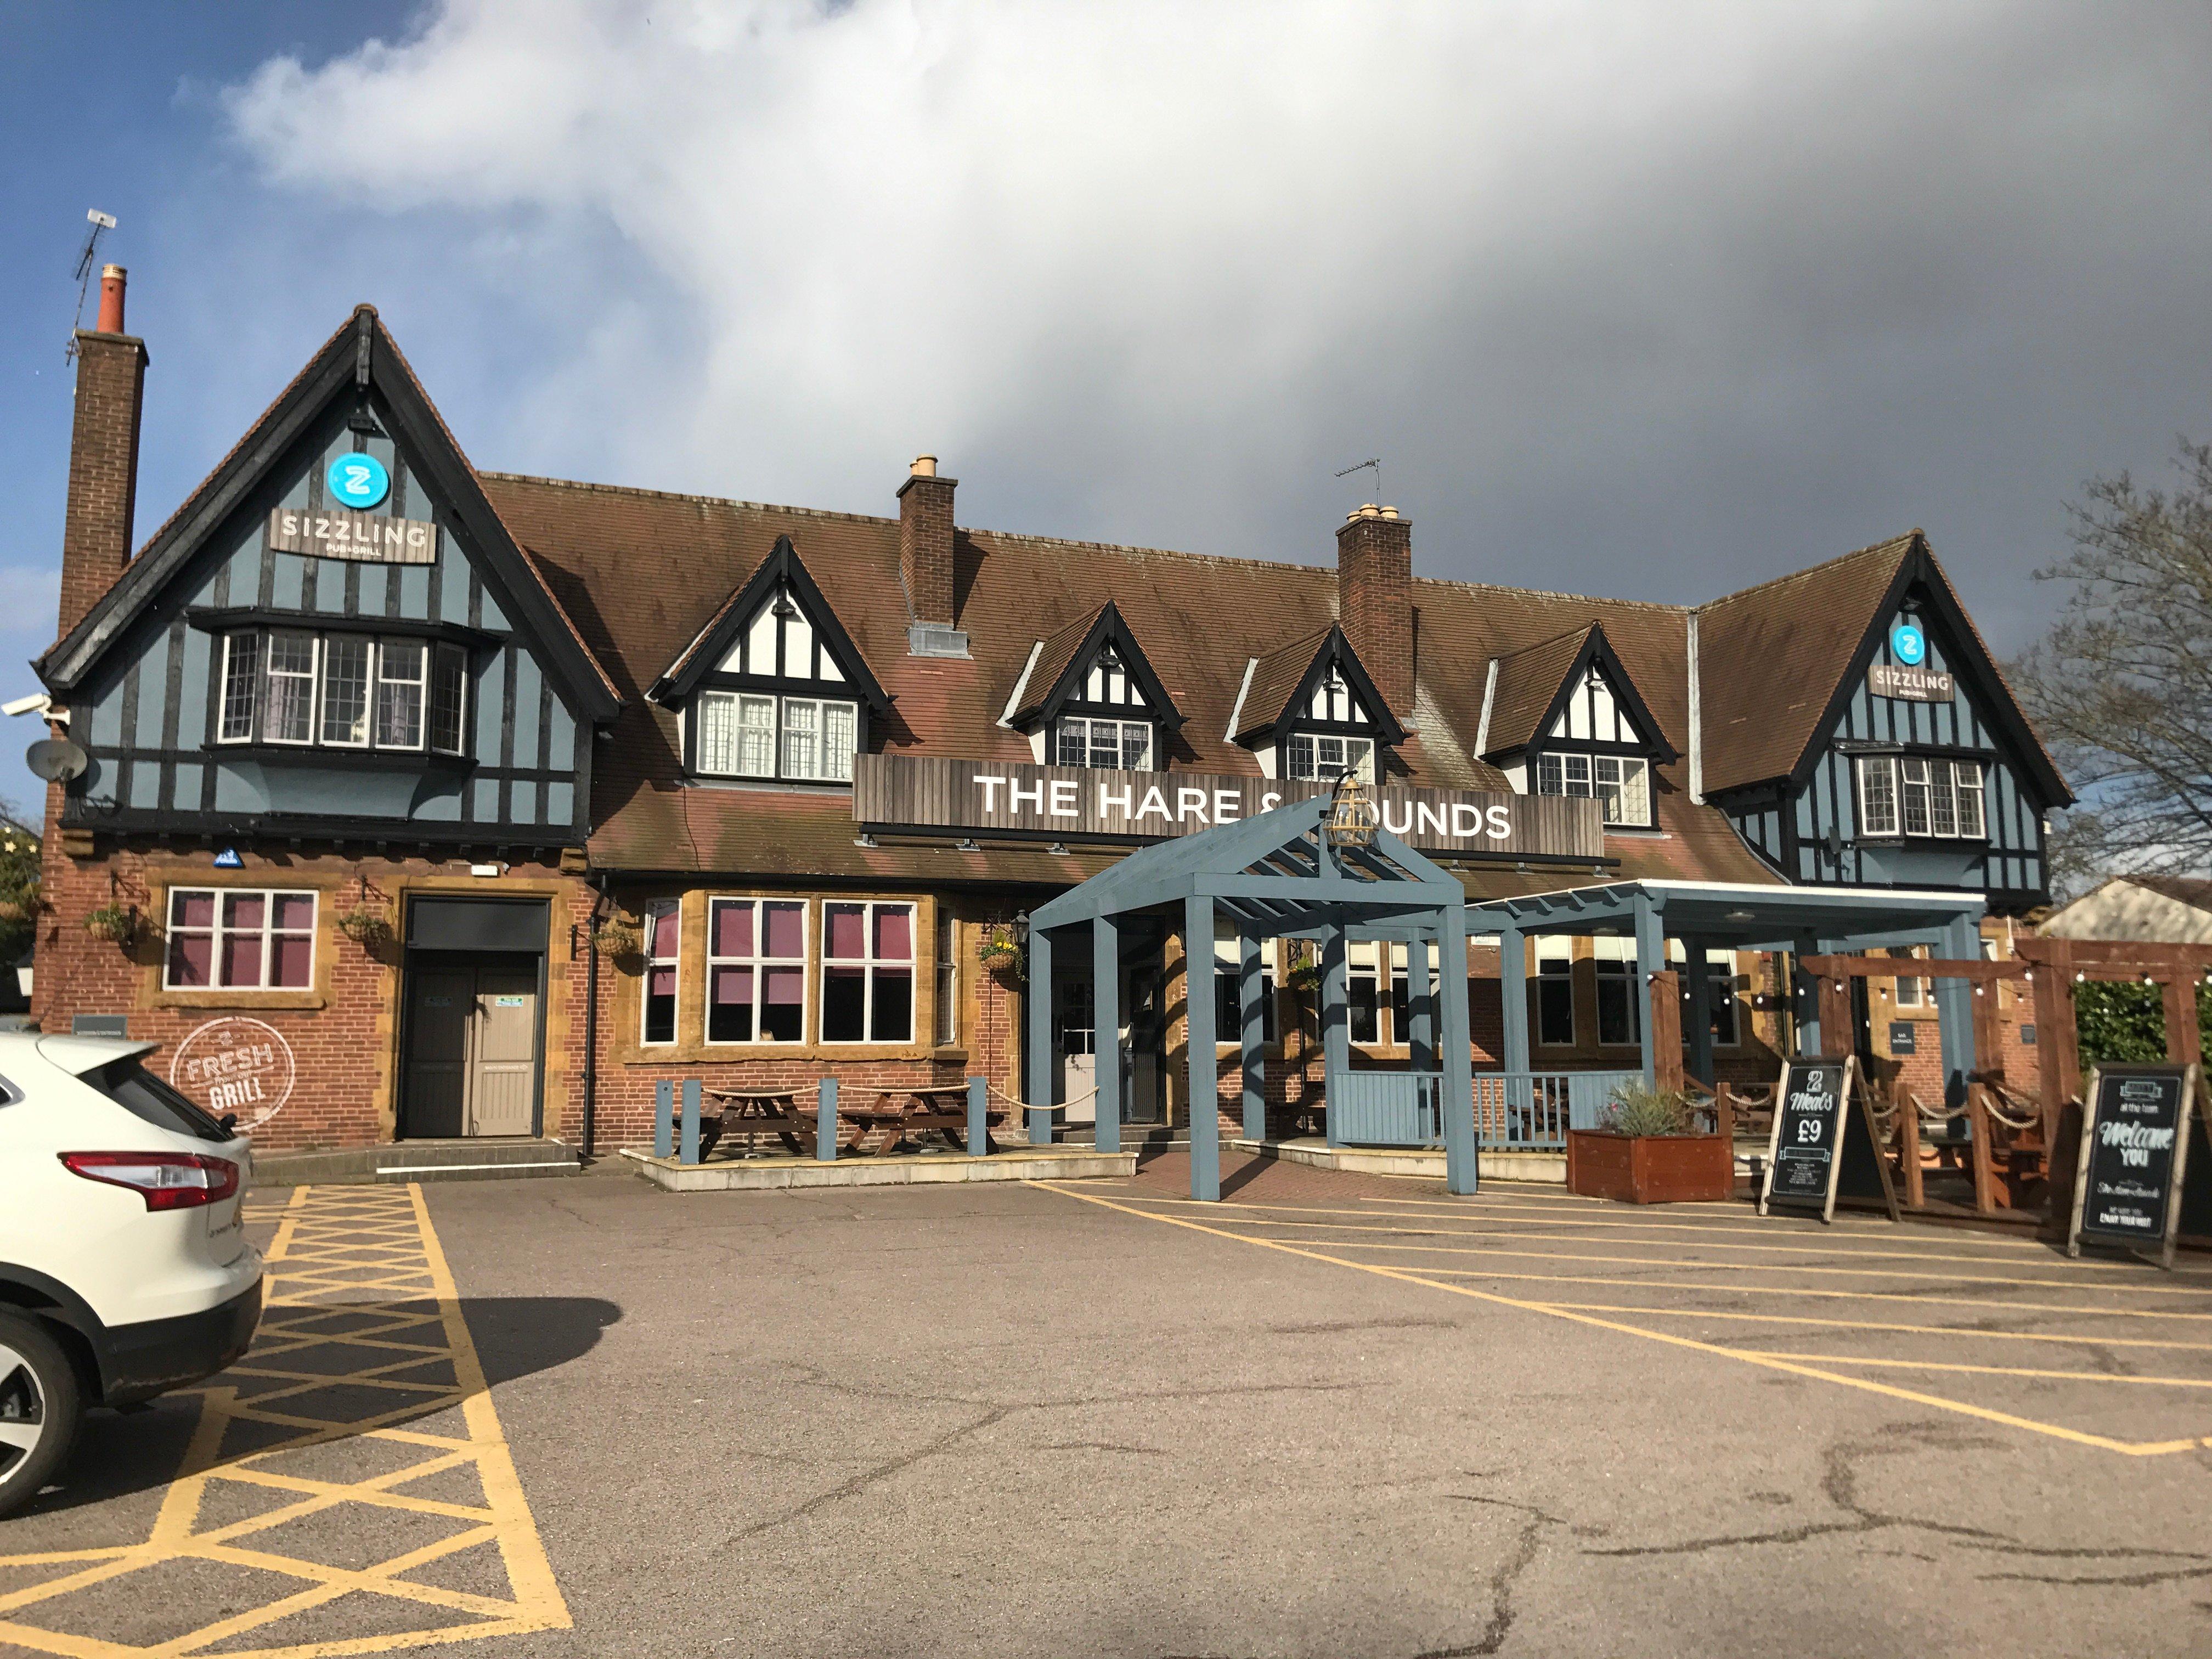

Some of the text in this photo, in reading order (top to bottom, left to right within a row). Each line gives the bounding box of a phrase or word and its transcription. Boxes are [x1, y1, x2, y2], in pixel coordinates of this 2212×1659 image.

[283, 515, 425, 547] SIZZLING
[352, 545, 381, 556] GRILL
[1876, 670, 1948, 691] SIZZLING
[973, 775, 1078, 817] THE
[1099, 783, 1241, 824] HARE
[1311, 795, 1511, 839] UNDS
[187, 1043, 273, 1081] FRESH
[209, 1077, 267, 1110] GRILL
[1807, 1070, 1823, 1092] 2
[1798, 1120, 1821, 1143] £9
[2099, 1120, 2174, 1150] Welcome
